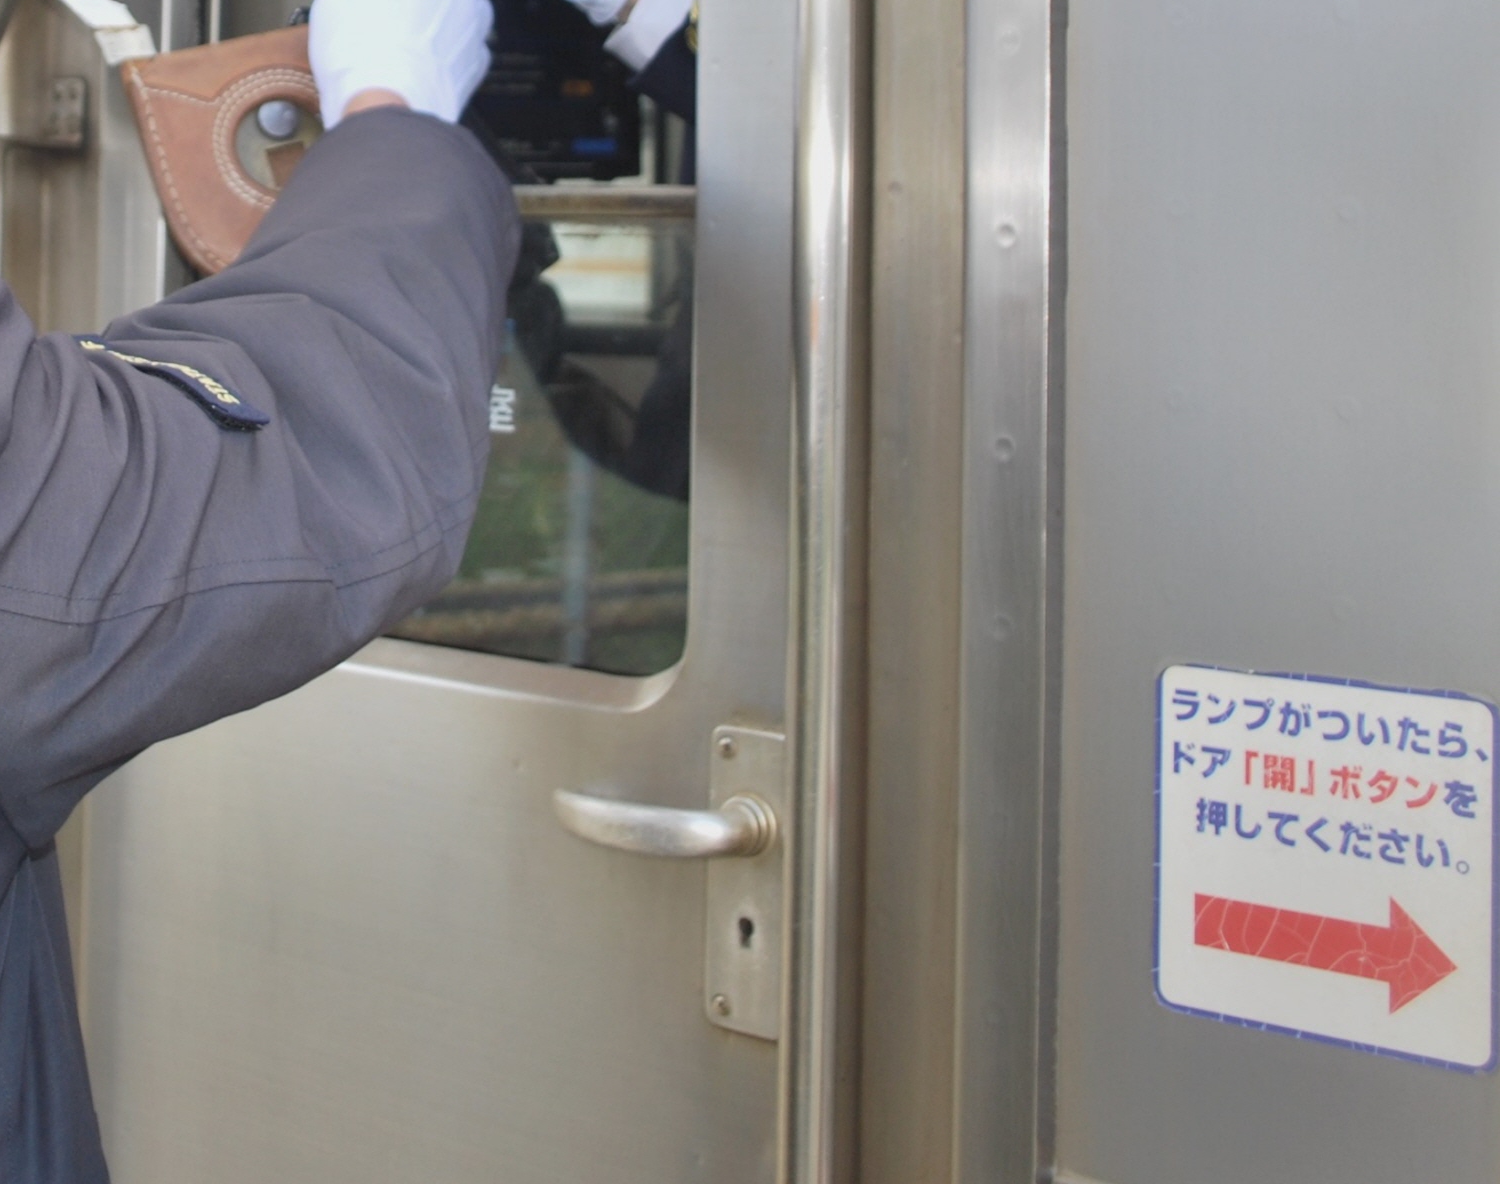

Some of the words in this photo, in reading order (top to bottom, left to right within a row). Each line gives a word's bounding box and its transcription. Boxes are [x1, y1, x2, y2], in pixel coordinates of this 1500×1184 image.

[1172, 688, 1488, 762] ランプがついたら、
[1196, 798, 1470, 874] 押してください。
